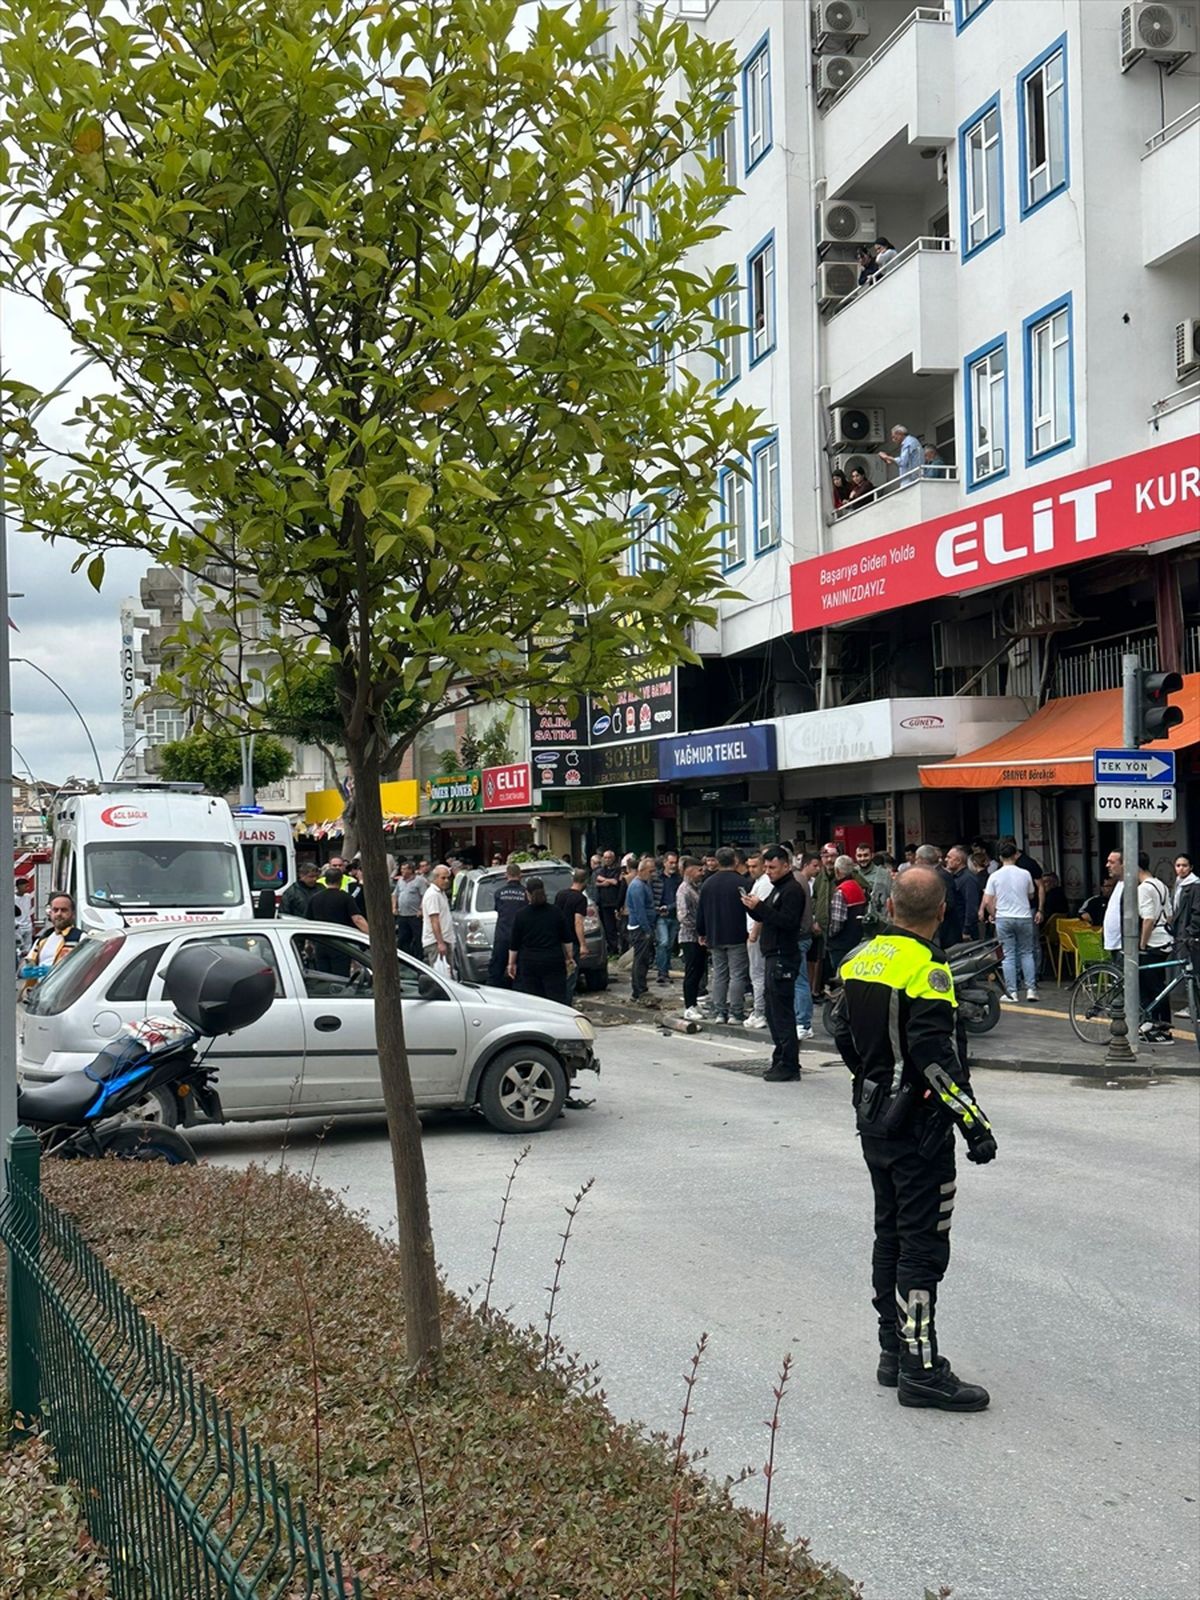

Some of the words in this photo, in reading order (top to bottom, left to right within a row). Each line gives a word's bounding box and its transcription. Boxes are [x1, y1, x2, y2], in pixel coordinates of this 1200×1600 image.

[1135, 466, 1200, 513] KUR
[820, 563, 858, 585] Başarıya
[860, 554, 887, 573] Giden
[889, 544, 915, 564] Yolda
[821, 578, 886, 609] YANINIZDAYIZ
[534, 729, 577, 741] SATIMI
[604, 743, 650, 768] SOYLU
[674, 744, 713, 766] YAĞMUR
[715, 741, 747, 761] TEKEL
[1102, 762, 1121, 771] TEK
[1126, 760, 1148, 771] YÖN
[1099, 797, 1122, 809] OTO
[1125, 797, 1155, 809] PARK
